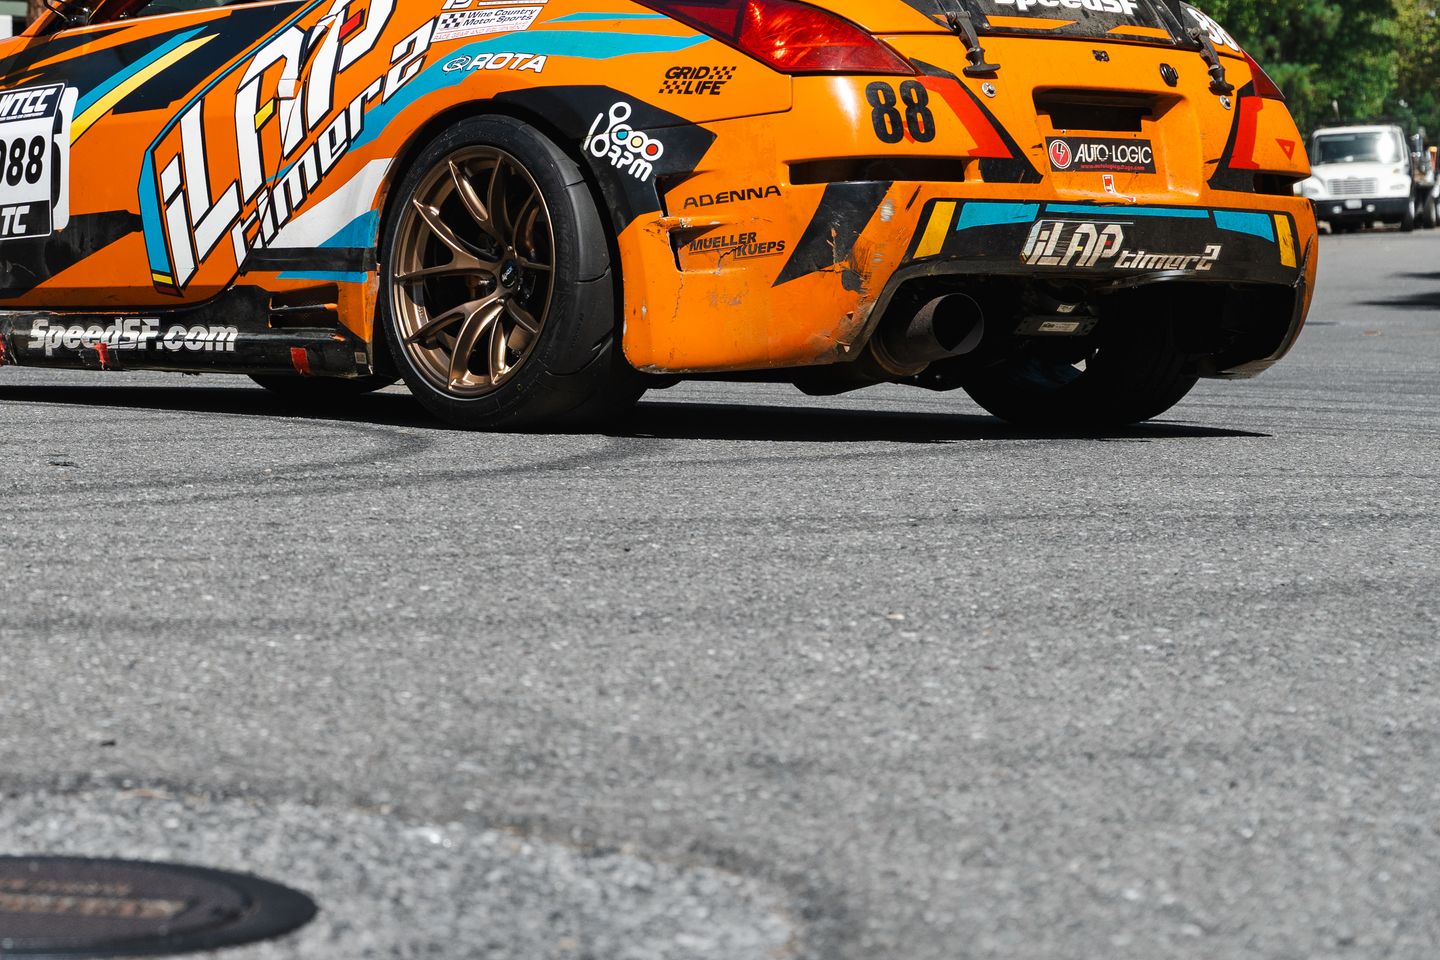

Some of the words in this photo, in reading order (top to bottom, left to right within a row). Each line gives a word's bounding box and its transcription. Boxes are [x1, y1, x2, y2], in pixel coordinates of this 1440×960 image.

[462, 17, 496, 26] Motor
[496, 15, 533, 24] Sports
[494, 8, 537, 17] Country
[466, 53, 548, 73] ROTA
[664, 66, 711, 80] GRID
[683, 81, 727, 95] LIFE
[865, 79, 936, 144] 88
[683, 185, 782, 209] ADENNA
[1, 205, 30, 235] TC
[689, 232, 757, 251] MUELLER
[735, 240, 786, 257] KUEPS
[28, 317, 239, 357] SpeedSF.com
